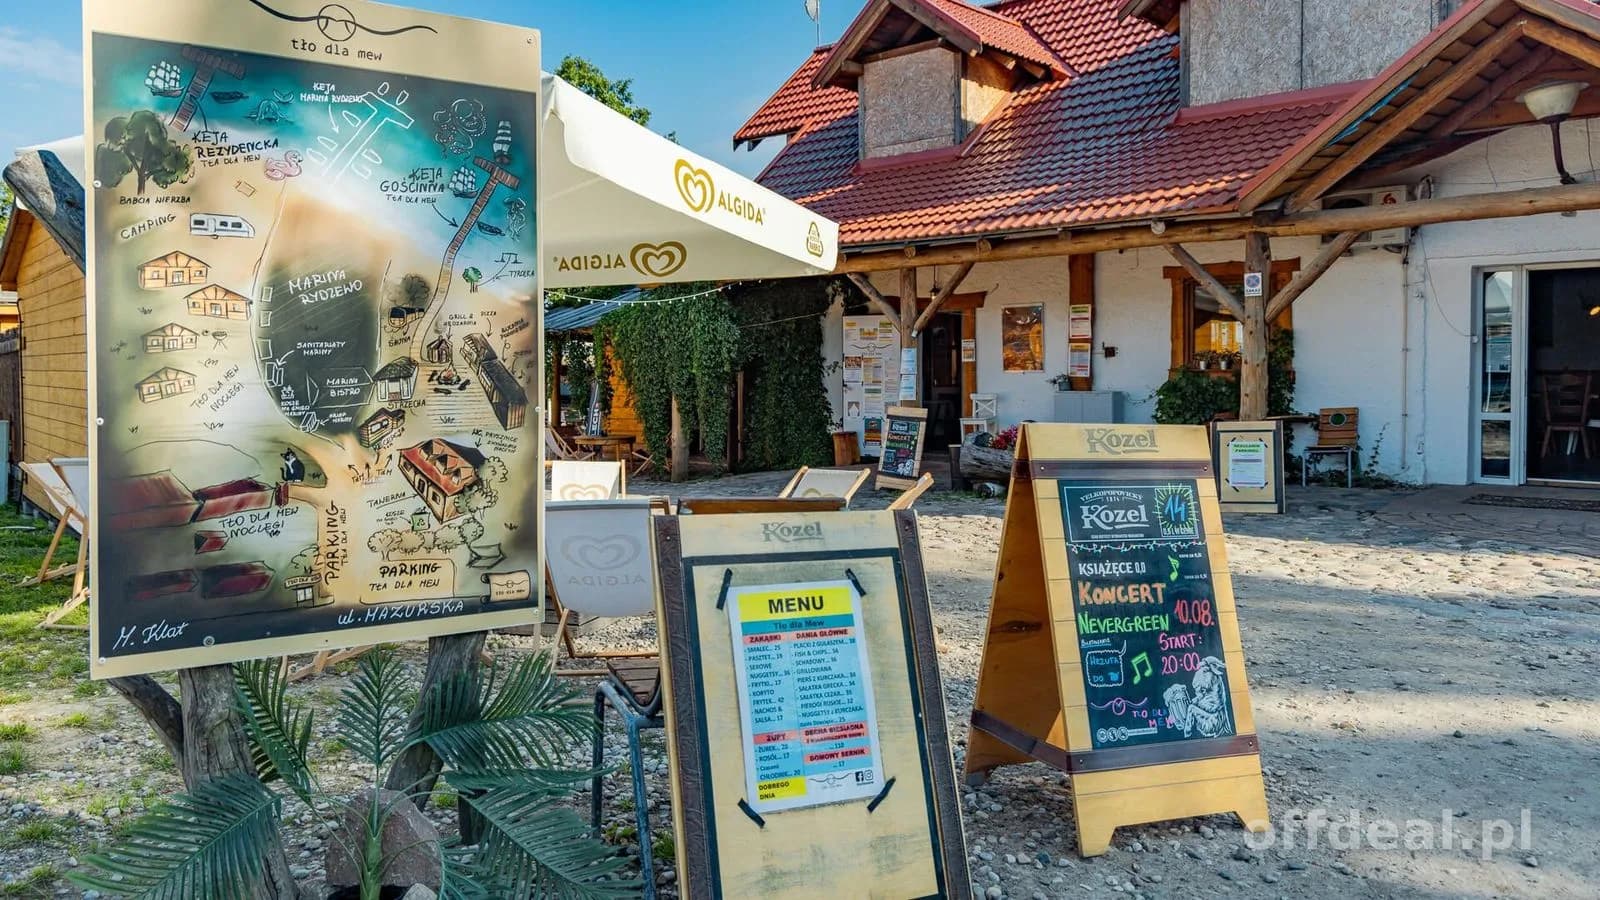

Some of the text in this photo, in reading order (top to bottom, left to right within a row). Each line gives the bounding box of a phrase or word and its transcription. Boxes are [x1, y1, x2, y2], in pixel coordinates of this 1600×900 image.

[291, 38, 383, 61] tło dla mew
[312, 82, 335, 92] KEJA
[191, 130, 228, 144] KEJA
[194, 138, 278, 158] REZYDENCKA
[200, 158, 219, 168] TŁA
[223, 156, 239, 165] DLA
[408, 167, 443, 181] KEJA
[380, 177, 446, 193] GOŚCINNA
[405, 196, 419, 204] DLA
[718, 189, 763, 226] ALGIDA
[120, 213, 177, 241] CAMPING
[288, 269, 346, 295] MARINA
[298, 279, 363, 305] RYDZEWO
[330, 388, 361, 398] BISTRO
[1085, 428, 1160, 455] Kozel
[218, 505, 300, 530] TŁO DLA MEW
[1079, 504, 1150, 530] Kozel
[1165, 495, 1187, 522] 14
[229, 520, 286, 538] NOCLEGI
[760, 521, 824, 544] Kozel
[324, 500, 341, 585] PARKING
[379, 562, 442, 578] PARKING
[1078, 560, 1132, 577] KSIĄŻĘCE
[369, 578, 440, 592] TŁA DLA MEW
[1078, 581, 1167, 605] KONCERT
[337, 599, 464, 626] ul. MAZURSKA
[768, 596, 824, 614] MENU
[1174, 599, 1215, 626] 10.08.
[1078, 611, 1169, 634] NEVERGREEN
[795, 631, 819, 640] DANIA
[1161, 652, 1200, 675] 20:00
[758, 781, 790, 791] DOBREGO
[759, 792, 776, 800] DNIA
